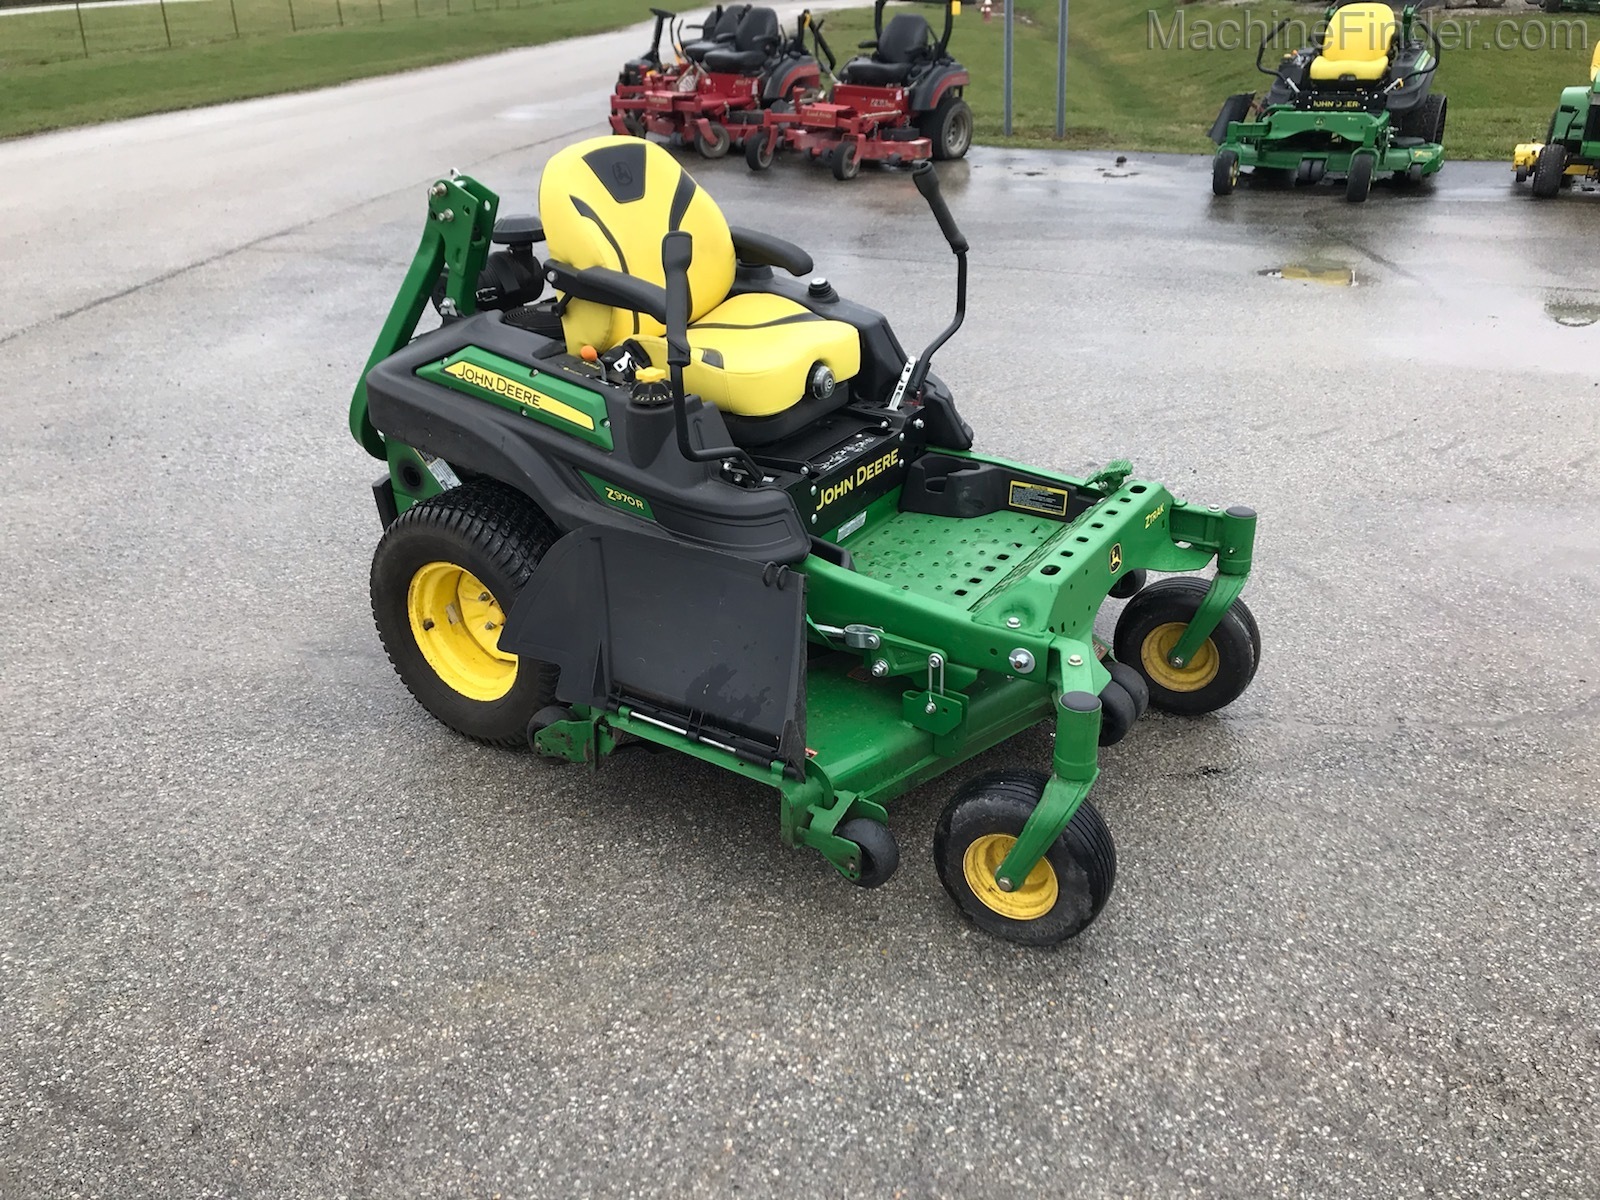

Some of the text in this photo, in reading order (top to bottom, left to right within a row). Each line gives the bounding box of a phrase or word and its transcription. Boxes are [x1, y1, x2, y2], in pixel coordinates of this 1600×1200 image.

[458, 365, 541, 407] JOHN DEERE
[605, 487, 644, 510] Z970R
[816, 475, 854, 511] JOHN
[856, 448, 899, 487] DEERE
